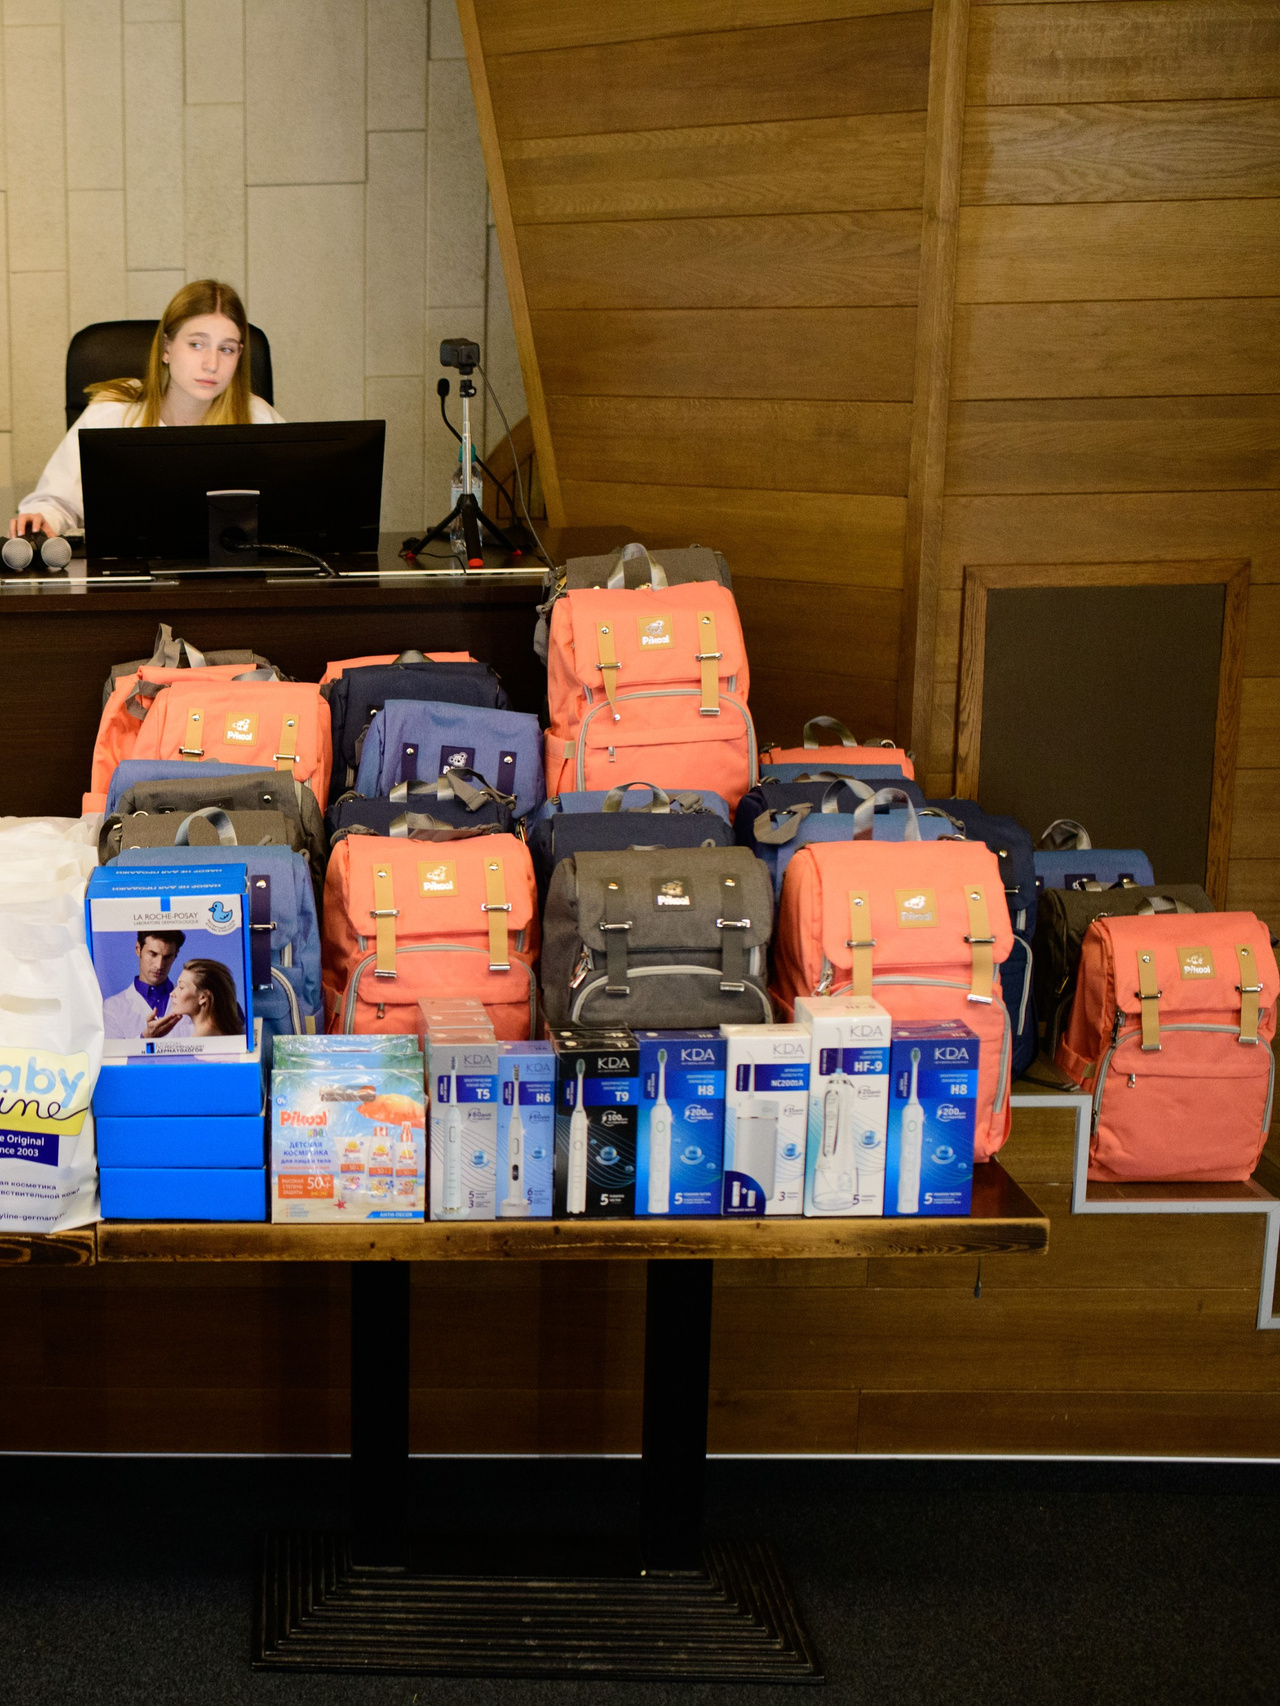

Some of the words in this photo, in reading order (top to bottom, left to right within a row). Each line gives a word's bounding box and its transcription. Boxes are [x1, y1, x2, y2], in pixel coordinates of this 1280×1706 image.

[641, 634, 670, 645] Pikool
[227, 730, 253, 741] Pikool
[423, 880, 454, 891] Pikool
[657, 895, 691, 906] Pikool
[144, 912, 199, 920] ROCHE-POSAY
[1183, 965, 1211, 974] Pikool
[850, 1025, 883, 1038] KDA
[681, 1048, 715, 1061] KDA
[773, 1043, 805, 1055] KDA
[934, 1047, 969, 1060] KDA
[463, 1054, 492, 1065] KDA
[597, 1057, 630, 1069] KDA
[526, 1063, 551, 1072] KDA
[854, 1061, 883, 1072] HF-9
[476, 1088, 491, 1100] T5
[698, 1085, 715, 1096] H8
[950, 1084, 968, 1095] H8
[536, 1093, 551, 1103] H6
[615, 1091, 630, 1102] T9
[279, 1110, 328, 1127] Pikool
[6, 1134, 45, 1146] Original
[289, 1141, 323, 1149] ДЕТСКАЯ
[17, 1148, 39, 1157] 2003
[11, 1181, 57, 1190] косметика
[469, 1190, 474, 1199] 5
[600, 1194, 609, 1206] 5
[674, 1193, 683, 1205] 5
[779, 1192, 785, 1201] 3
[852, 1194, 860, 1205] 5
[923, 1192, 934, 1205] 5
[469, 1200, 474, 1208] 3
